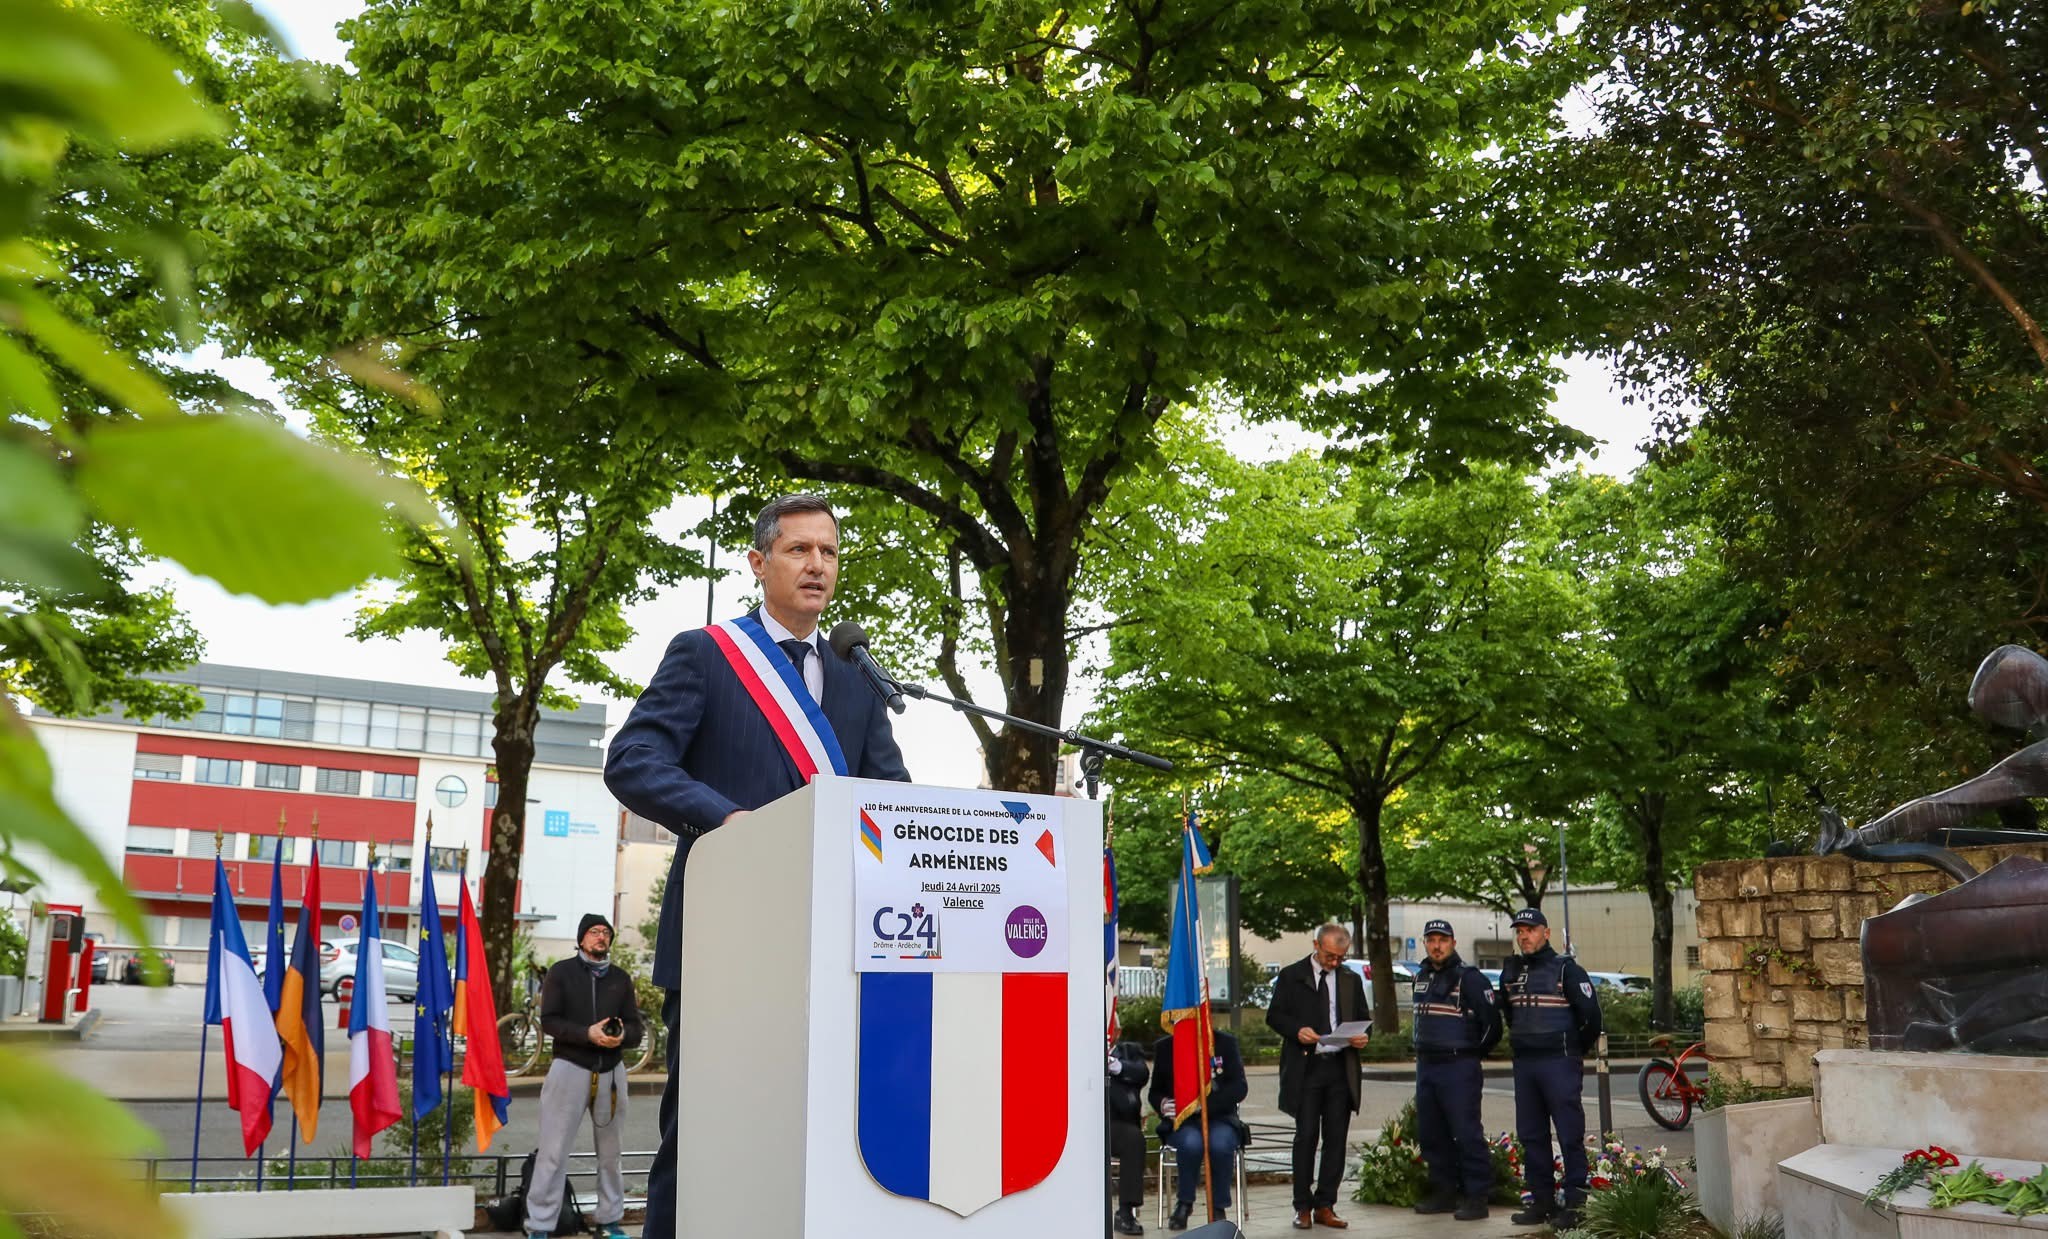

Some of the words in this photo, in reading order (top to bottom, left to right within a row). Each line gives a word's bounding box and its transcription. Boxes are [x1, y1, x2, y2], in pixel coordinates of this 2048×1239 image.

[864, 803, 877, 811] 110
[894, 805, 951, 815] ANNIVERSAIRE
[952, 808, 961, 816] DE
[962, 808, 972, 816] LA
[973, 809, 1035, 820] COMMEMORATION
[1036, 813, 1047, 821] DU
[893, 819, 985, 842] GÉNOCIDE
[989, 828, 1020, 845] DES
[908, 849, 1008, 872] ARMÉNIENS
[920, 881, 944, 892] Jeudi
[946, 883, 956, 891] 24
[958, 883, 979, 892] Avril
[981, 884, 1001, 893] 2025
[942, 896, 984, 908] Valence
[873, 906, 936, 949] C24
[1007, 923, 1046, 939] VALENCE
[873, 941, 894, 949] Drôme
[897, 941, 922, 950] Ardèche
